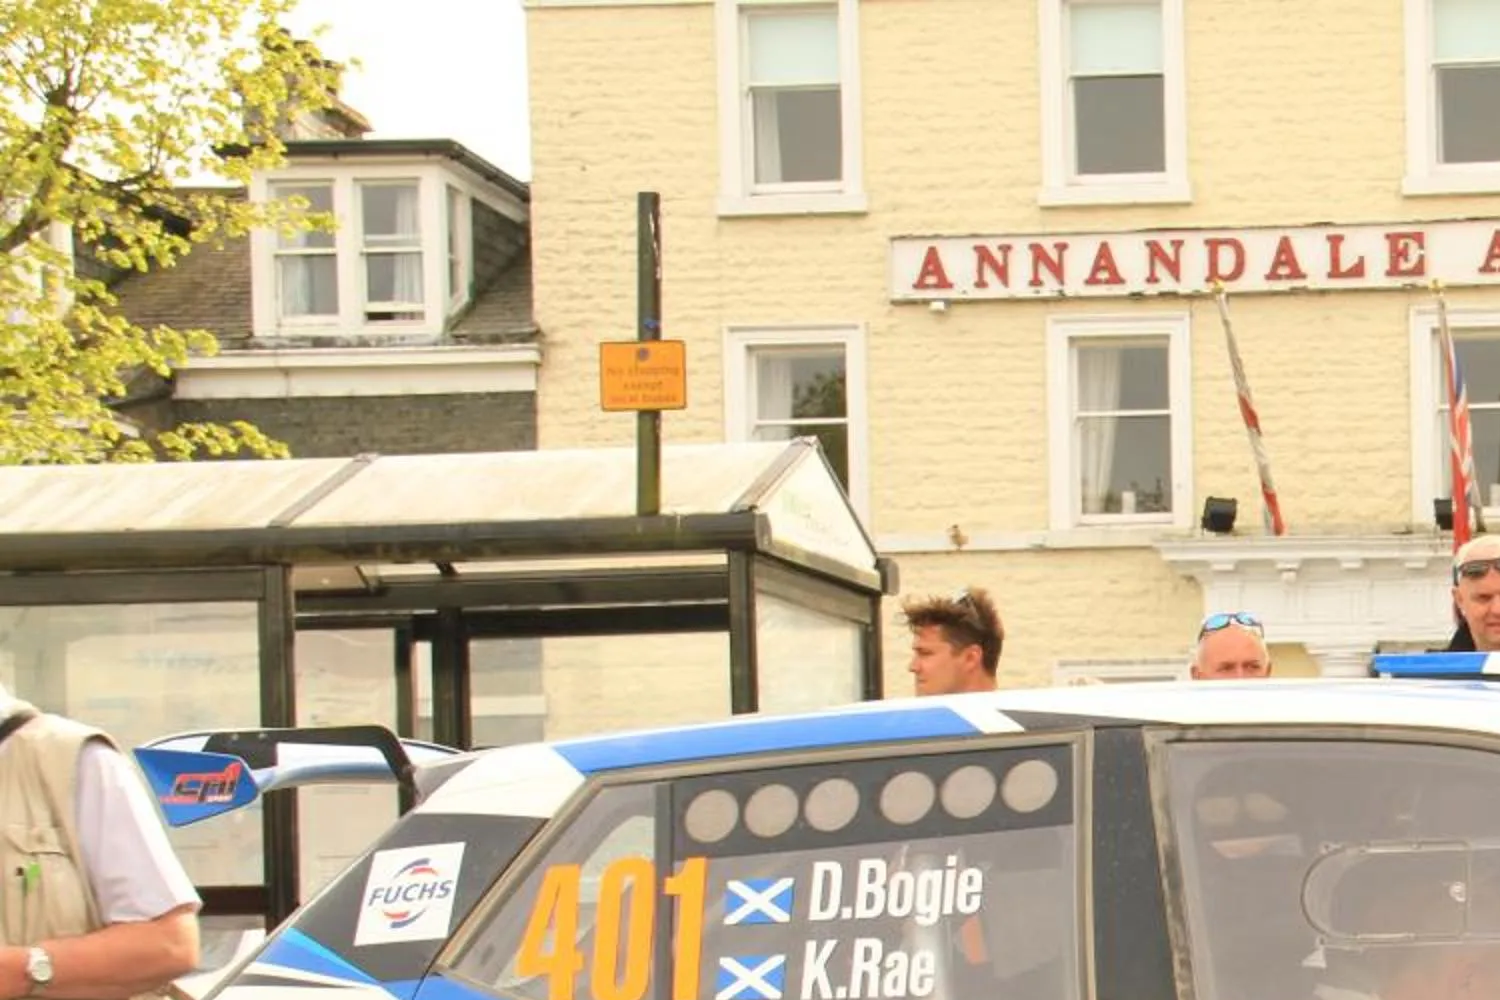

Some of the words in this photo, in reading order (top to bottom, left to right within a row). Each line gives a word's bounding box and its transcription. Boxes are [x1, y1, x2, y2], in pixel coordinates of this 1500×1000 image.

[912, 231, 1425, 290] ANNANDALE
[367, 879, 454, 907] FUCHS
[808, 855, 984, 928] D.Bogie
